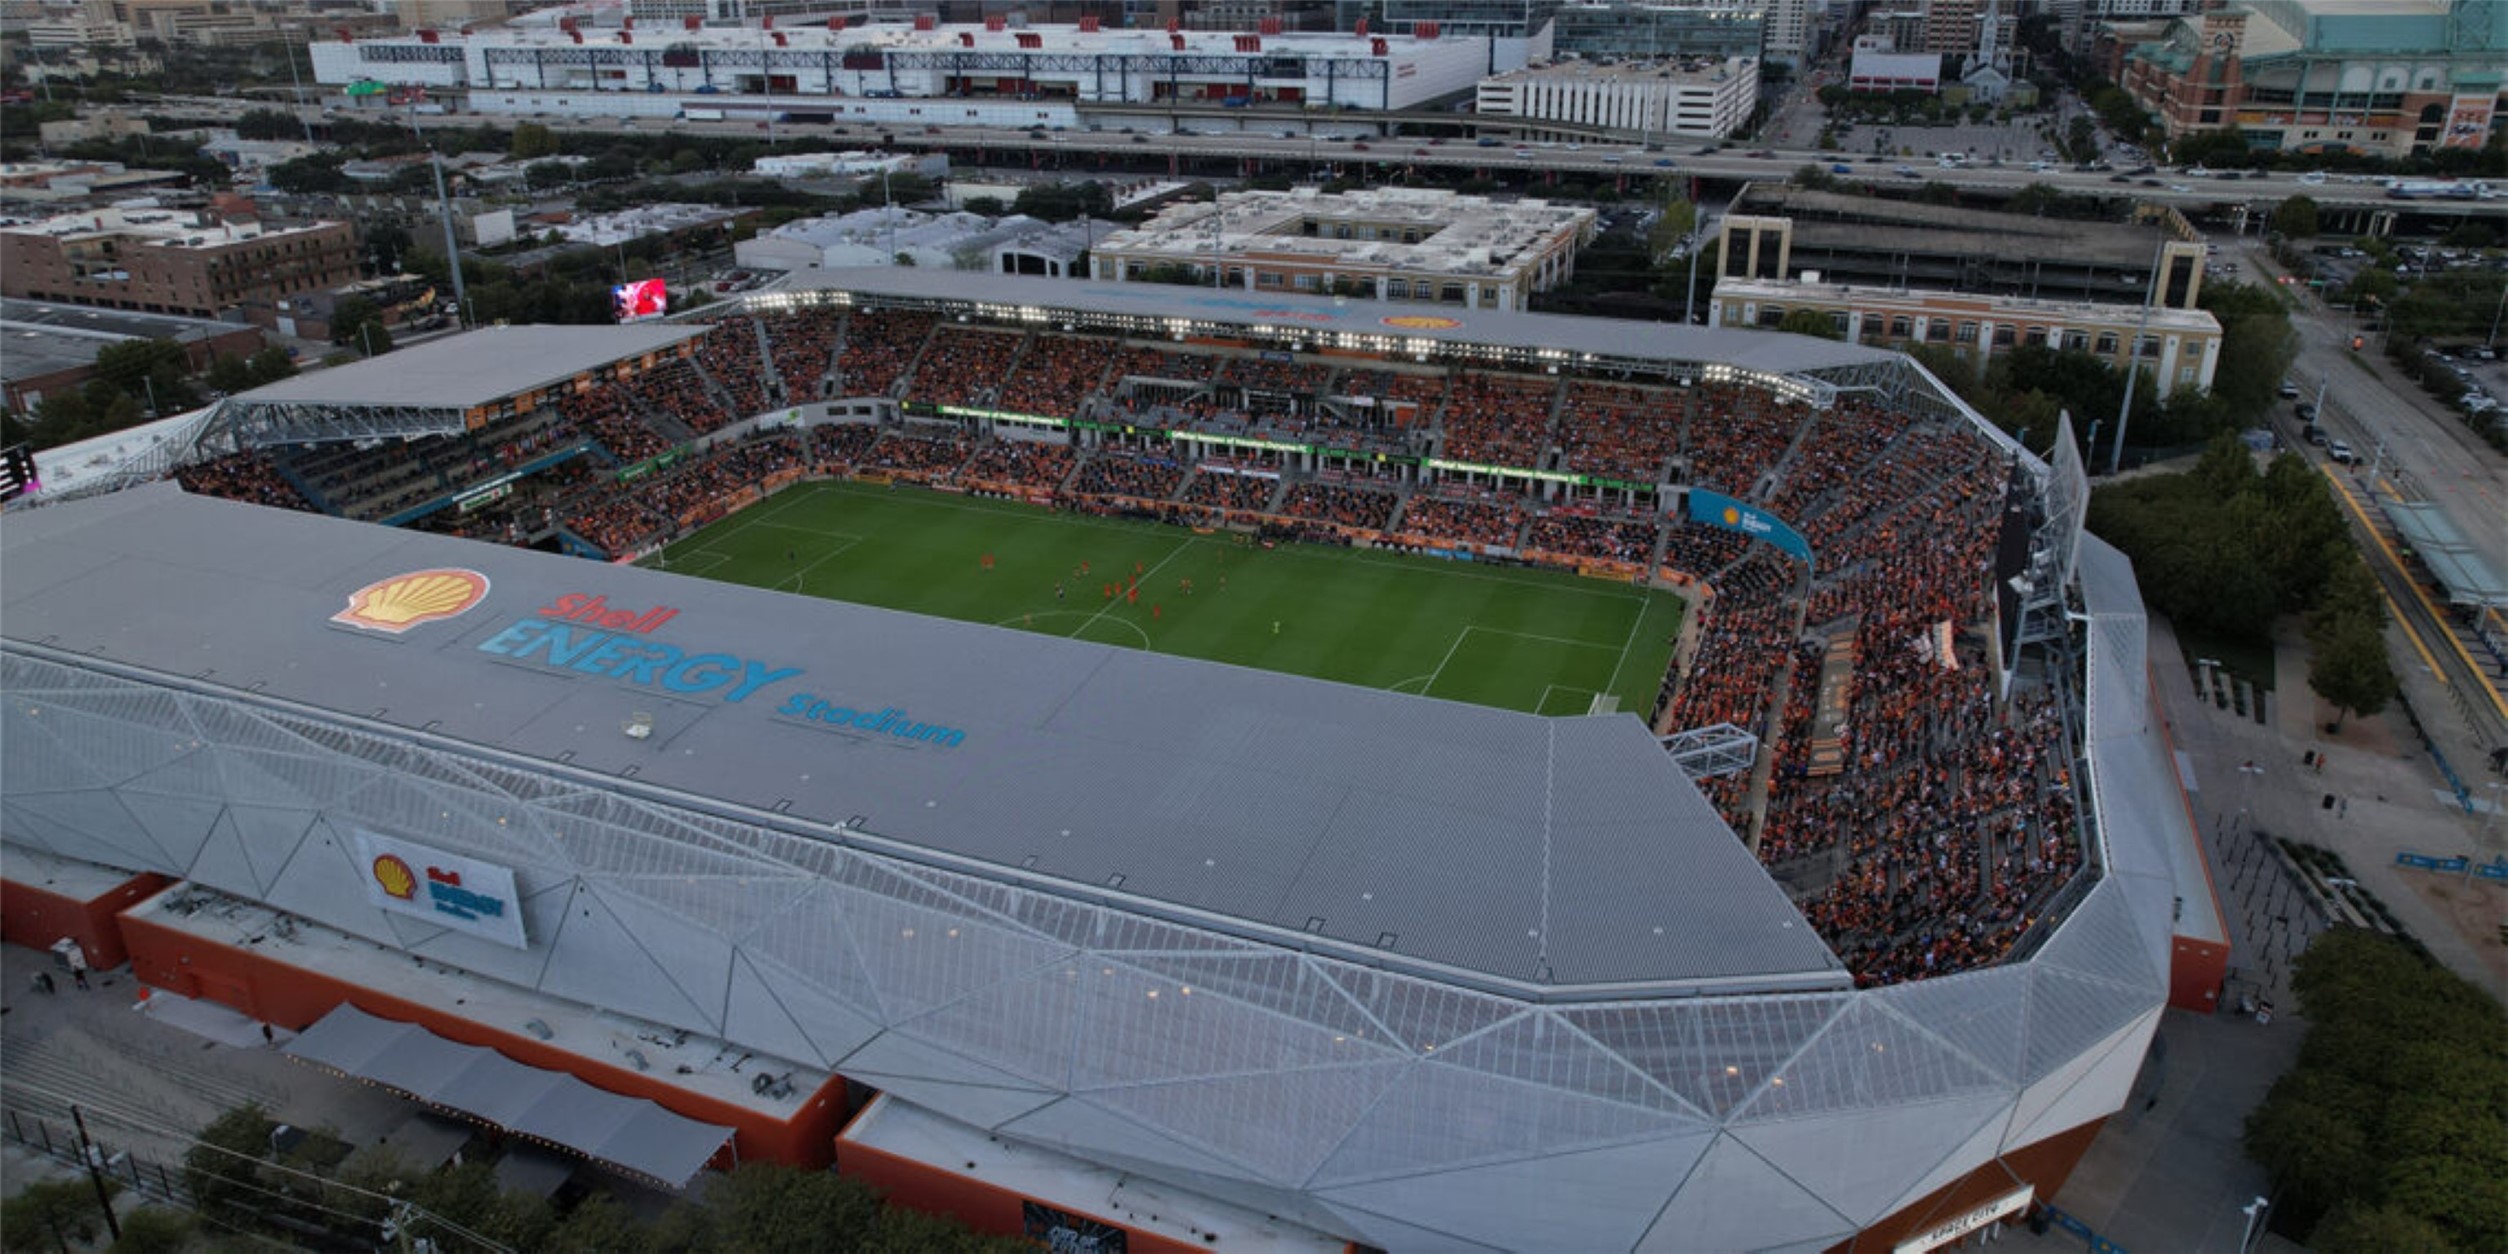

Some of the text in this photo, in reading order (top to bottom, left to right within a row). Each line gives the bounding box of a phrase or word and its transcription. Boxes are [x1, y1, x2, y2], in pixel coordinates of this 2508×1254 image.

[537, 593, 681, 634] Shell
[477, 618, 805, 702] ENERGY
[775, 692, 968, 748] Stadium
